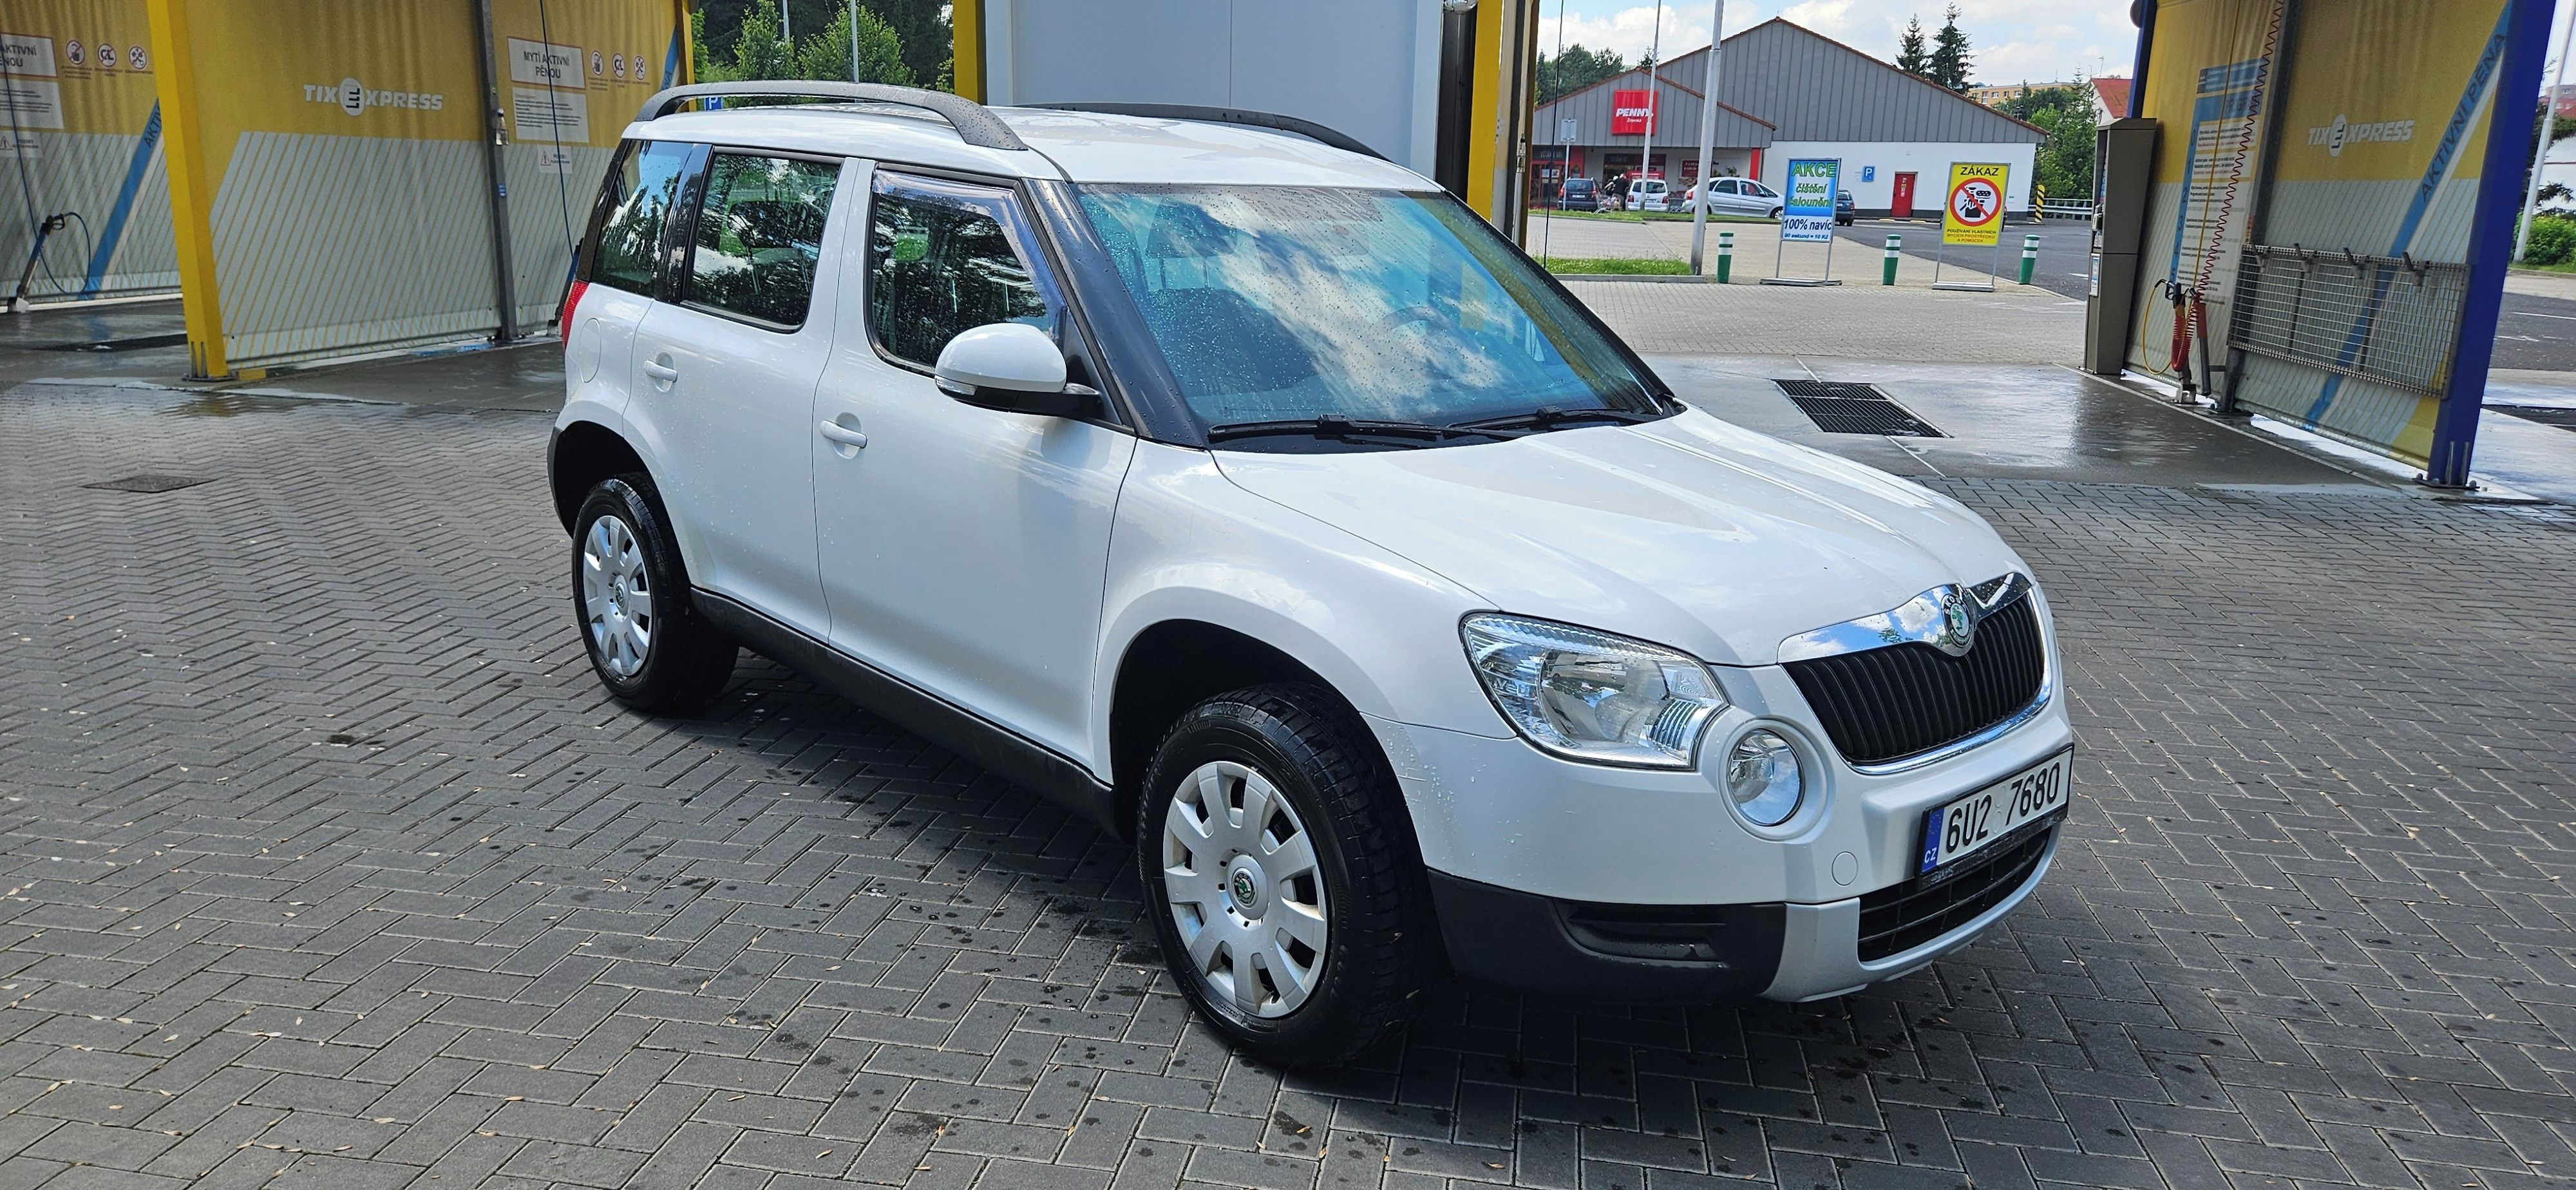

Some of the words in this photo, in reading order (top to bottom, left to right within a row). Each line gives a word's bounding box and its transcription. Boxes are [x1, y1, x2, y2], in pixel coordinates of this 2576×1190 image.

[524, 51, 541, 62] MYTÍ
[542, 53, 570, 66] AKTIVNÍ
[535, 65, 561, 78] PĚNOU
[1791, 162, 1838, 178] AKCE
[1960, 165, 2000, 176] ZÁKAZ
[1795, 183, 1828, 194] čištění
[1788, 196, 1834, 207] čalounění
[1784, 218, 1808, 231] 100%
[1809, 220, 1832, 231] navíc
[1946, 794, 1992, 854] 6U2
[2005, 762, 2060, 826] 7680
[1924, 847, 1937, 864] CZ
